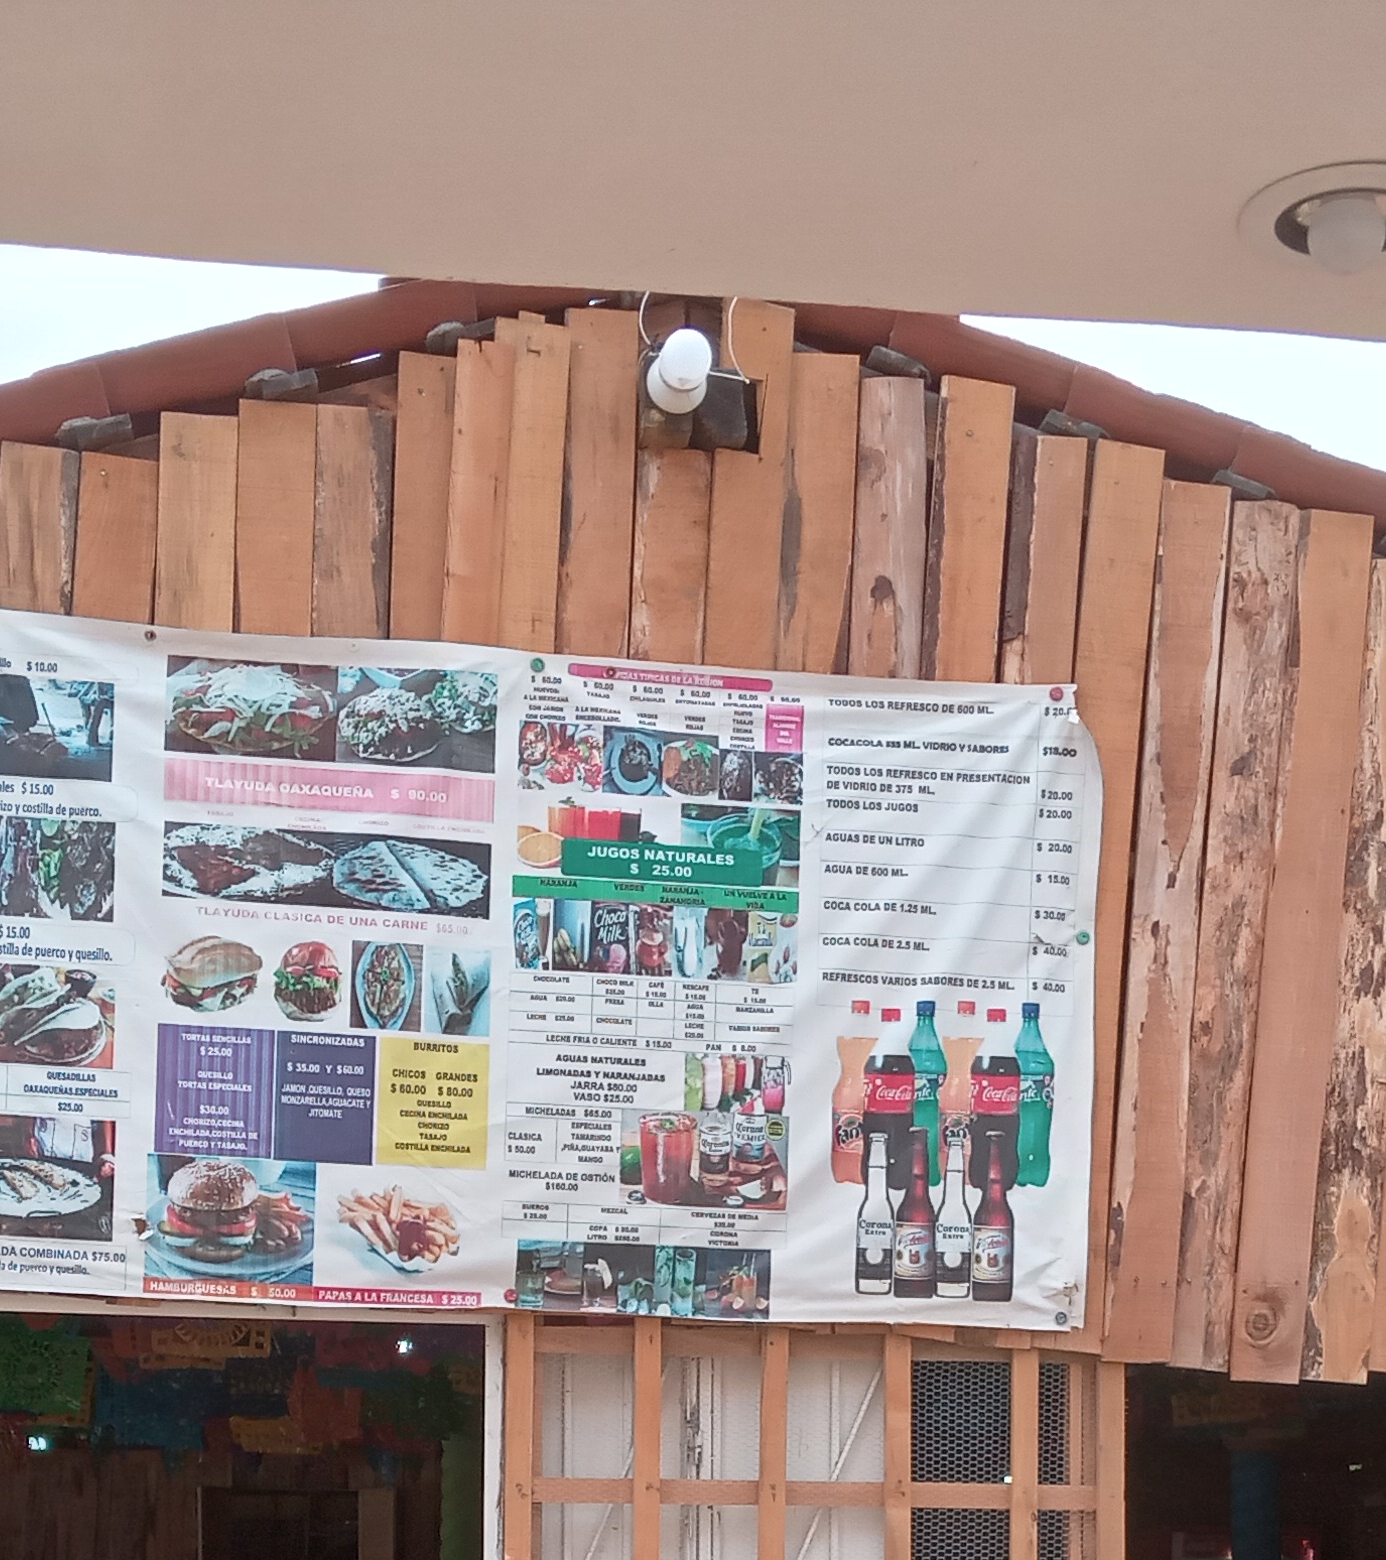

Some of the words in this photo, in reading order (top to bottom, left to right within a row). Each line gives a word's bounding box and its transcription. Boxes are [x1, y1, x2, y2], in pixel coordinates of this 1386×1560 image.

[33, 661, 58, 673] 10.00
[825, 765, 861, 776] TODOS
[862, 766, 883, 777] LOS
[885, 768, 937, 780] REFRESCO
[939, 771, 954, 781] EN
[955, 772, 1030, 785] PRESENTACION
[28, 782, 54, 795] 15.00
[204, 775, 276, 793] TLAYUDA
[279, 782, 374, 798] OAXAQUEÑA
[407, 787, 448, 804] 90.00
[825, 779, 840, 789] DE
[841, 780, 877, 792] VIDRIO
[878, 782, 893, 793] DE
[894, 783, 913, 794] 375
[917, 785, 935, 795] ML.
[13, 803, 21, 815] y
[21, 802, 54, 815] costilla
[54, 802, 67, 816] de
[68, 806, 102, 818] puerco.
[825, 798, 860, 810] TODOS
[861, 800, 882, 811] LOS
[883, 802, 919, 813] JUGOS
[824, 832, 860, 843] AGUAS
[861, 833, 876, 844] DE
[877, 835, 893, 845] UN
[894, 836, 925, 847] LITRO
[586, 845, 640, 859] JUGOS
[643, 848, 734, 865] NATURALES
[651, 863, 692, 877] 25.00
[823, 863, 853, 874] AGUA
[855, 865, 869, 875] DE
[870, 866, 889, 877] 600
[890, 867, 909, 877] ML.
[822, 900, 851, 911] COCA
[852, 901, 881, 911] COLA
[883, 902, 897, 912] DE
[899, 902, 918, 913] 1.25
[919, 904, 937, 915] ML.
[195, 905, 259, 919] TLAYUDA
[263, 911, 322, 923] CLASICA
[326, 914, 344, 925] DE
[348, 916, 378, 926] UNA
[381, 918, 428, 930] CARNE
[5, 925, 30, 939] 15.00
[20, 942, 33, 956] de
[33, 946, 66, 960] puerco
[67, 949, 74, 962] y
[74, 947, 113, 963] quesillo.
[821, 971, 879, 984] REFRESCOS
[880, 975, 917, 986] VARIOS
[919, 975, 964, 987] SABORES
[966, 977, 979, 988] DE
[980, 979, 995, 989] 2.5
[997, 980, 1015, 990] ML.
[179, 1032, 210, 1042] TORTAS
[211, 1034, 252, 1044] SENCILLAS
[290, 1033, 365, 1047] SINCRONIZADAS
[412, 1041, 459, 1053] BURRITOS
[554, 1053, 588, 1063] AGUAS
[590, 1055, 646, 1067] NATURALES
[391, 1068, 426, 1079] CHICOS
[434, 1071, 478, 1083] GRANDES
[535, 1067, 592, 1078] LIMONADAS
[593, 1070, 601, 1078] Y
[602, 1070, 666, 1082] NARANJADAS
[307, 1107, 343, 1118] JITOMATE
[524, 1105, 576, 1118] MICHELADAS
[583, 1108, 612, 1118] $65.00
[507, 1131, 542, 1142] CLASICA
[508, 1169, 564, 1180] MICHELADA
[565, 1172, 578, 1181] DE
[18, 1246, 89, 1260] COMBINADA
[91, 1250, 127, 1263] $75.00
[149, 1280, 236, 1295] HAMBURGUESAS
[267, 1287, 296, 1298] 50.00
[318, 1289, 352, 1300] PAPAS
[353, 1291, 362, 1301] A
[363, 1291, 377, 1302] LA
[379, 1292, 434, 1304] FRANCESA
[449, 1294, 478, 1306] 25.00
